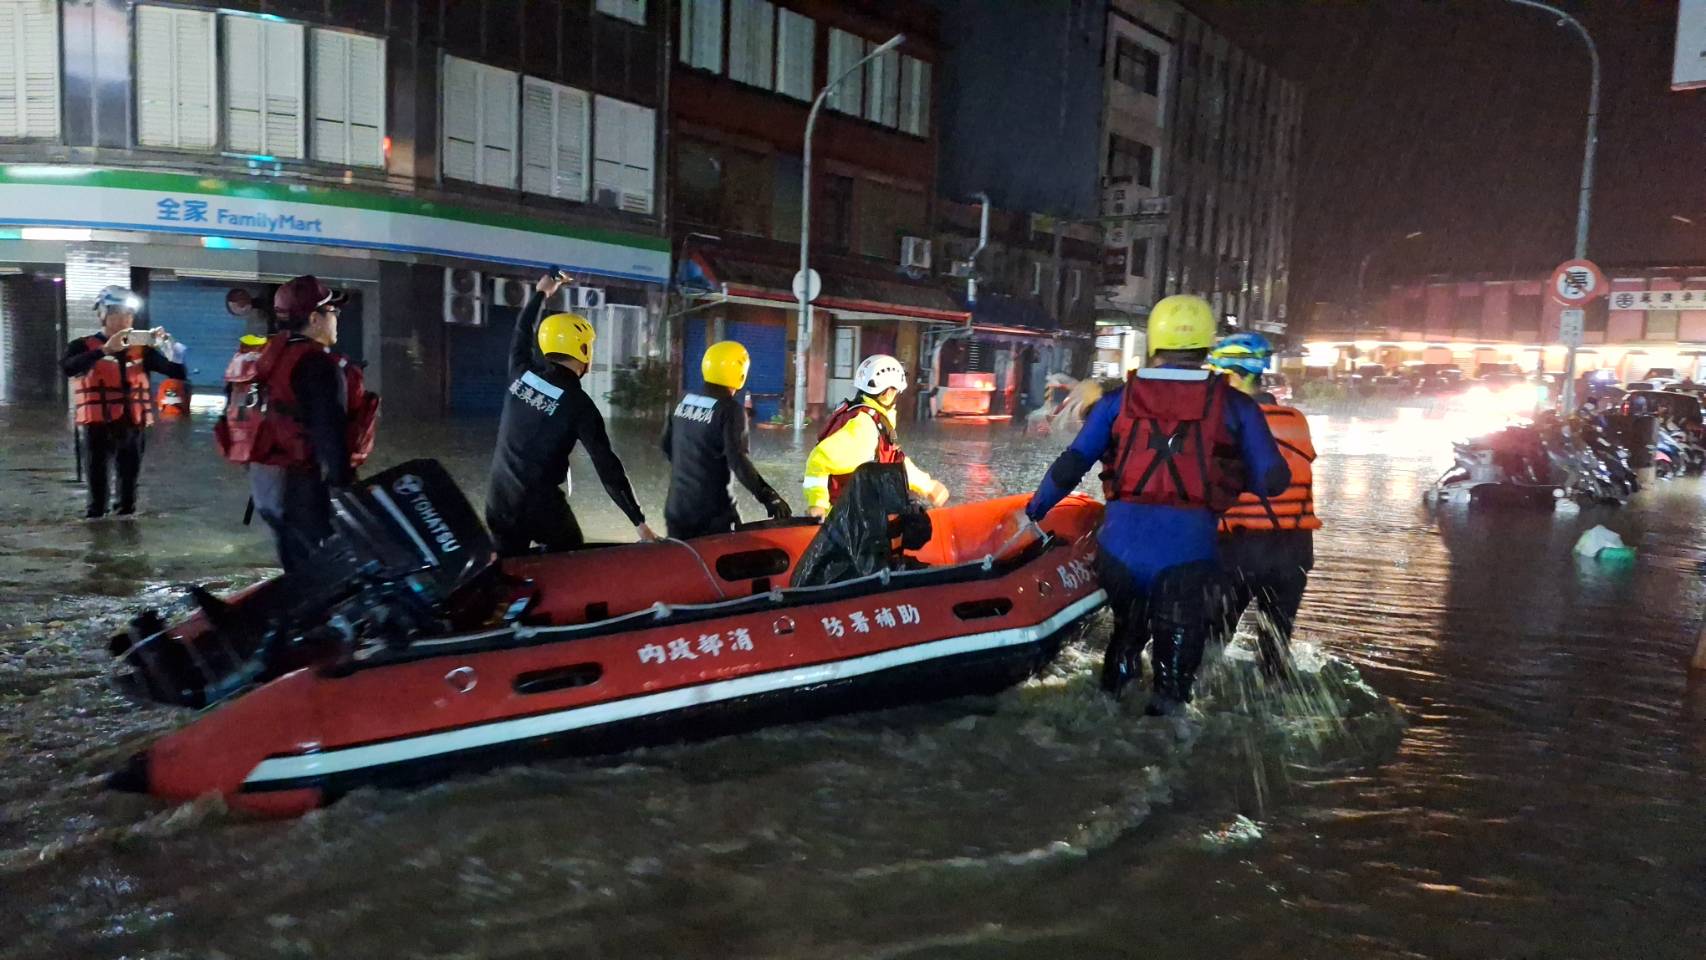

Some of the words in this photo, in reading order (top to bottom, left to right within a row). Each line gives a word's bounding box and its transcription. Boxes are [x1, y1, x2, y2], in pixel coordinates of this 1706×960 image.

[157, 198, 208, 222] 全家
[217, 208, 322, 232] FamilyMart
[410, 494, 461, 552] TOHATSU
